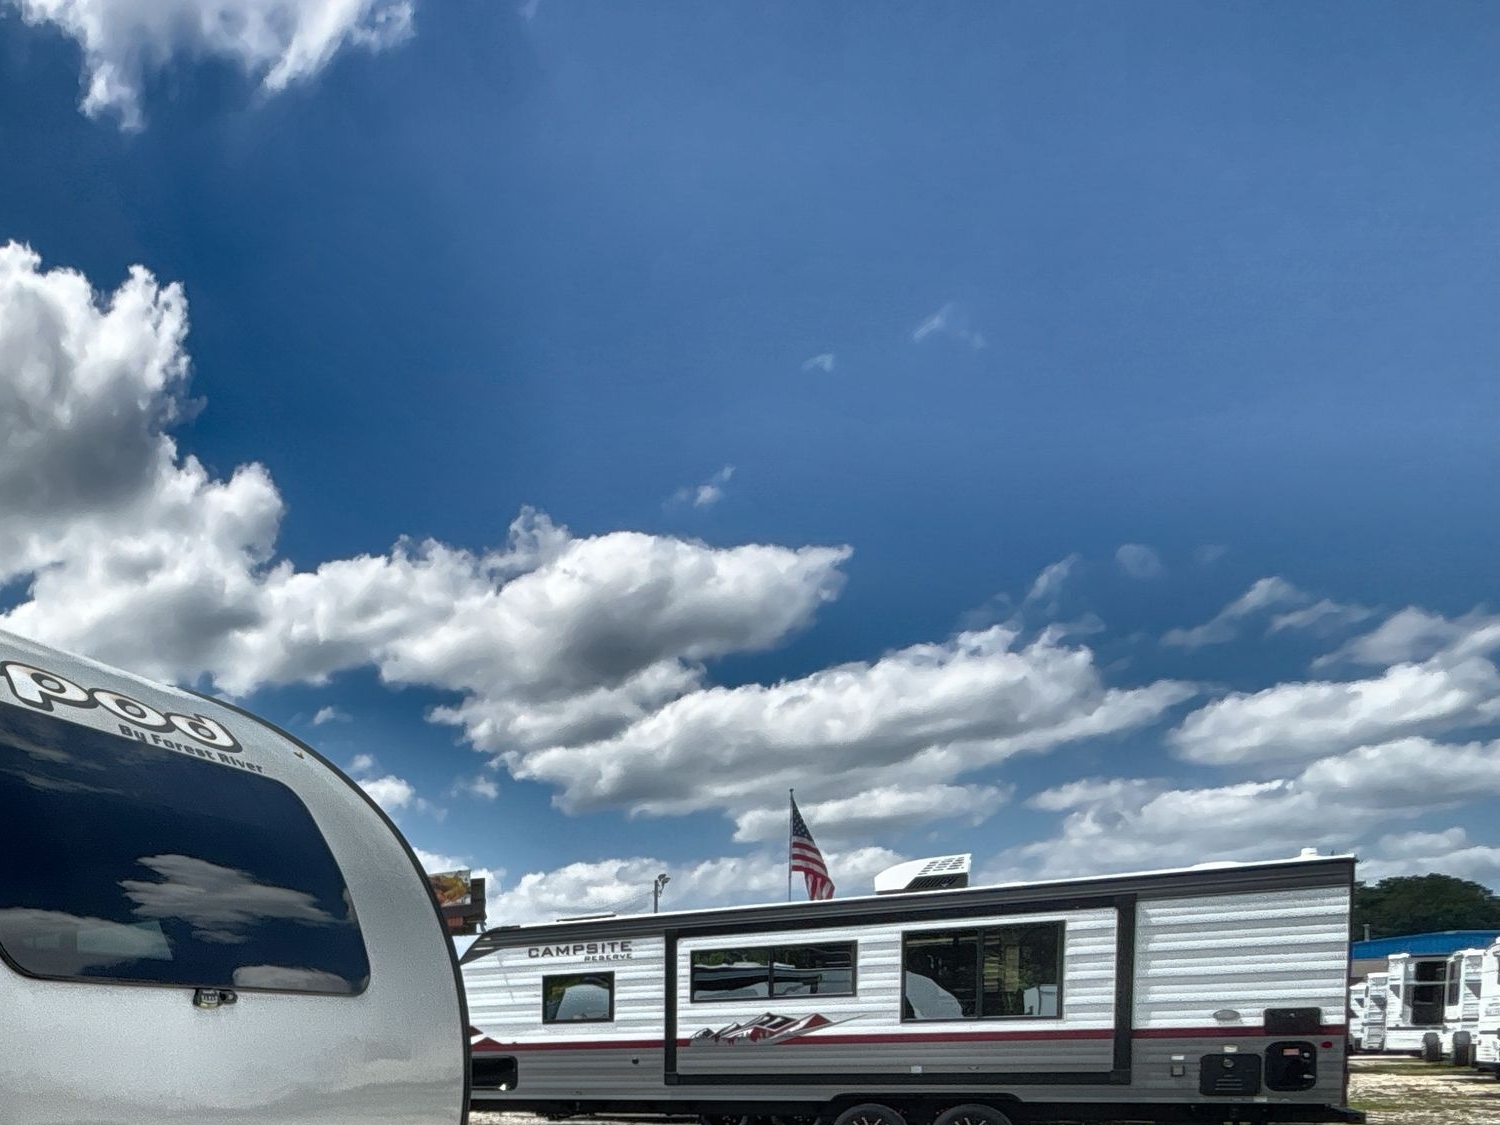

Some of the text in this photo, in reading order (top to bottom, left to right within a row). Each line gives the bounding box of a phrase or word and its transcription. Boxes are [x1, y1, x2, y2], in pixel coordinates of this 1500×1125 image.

[118, 724, 264, 774] By Forest River
[528, 941, 632, 958] CAMPSITE
[584, 953, 633, 962] RESERVE
